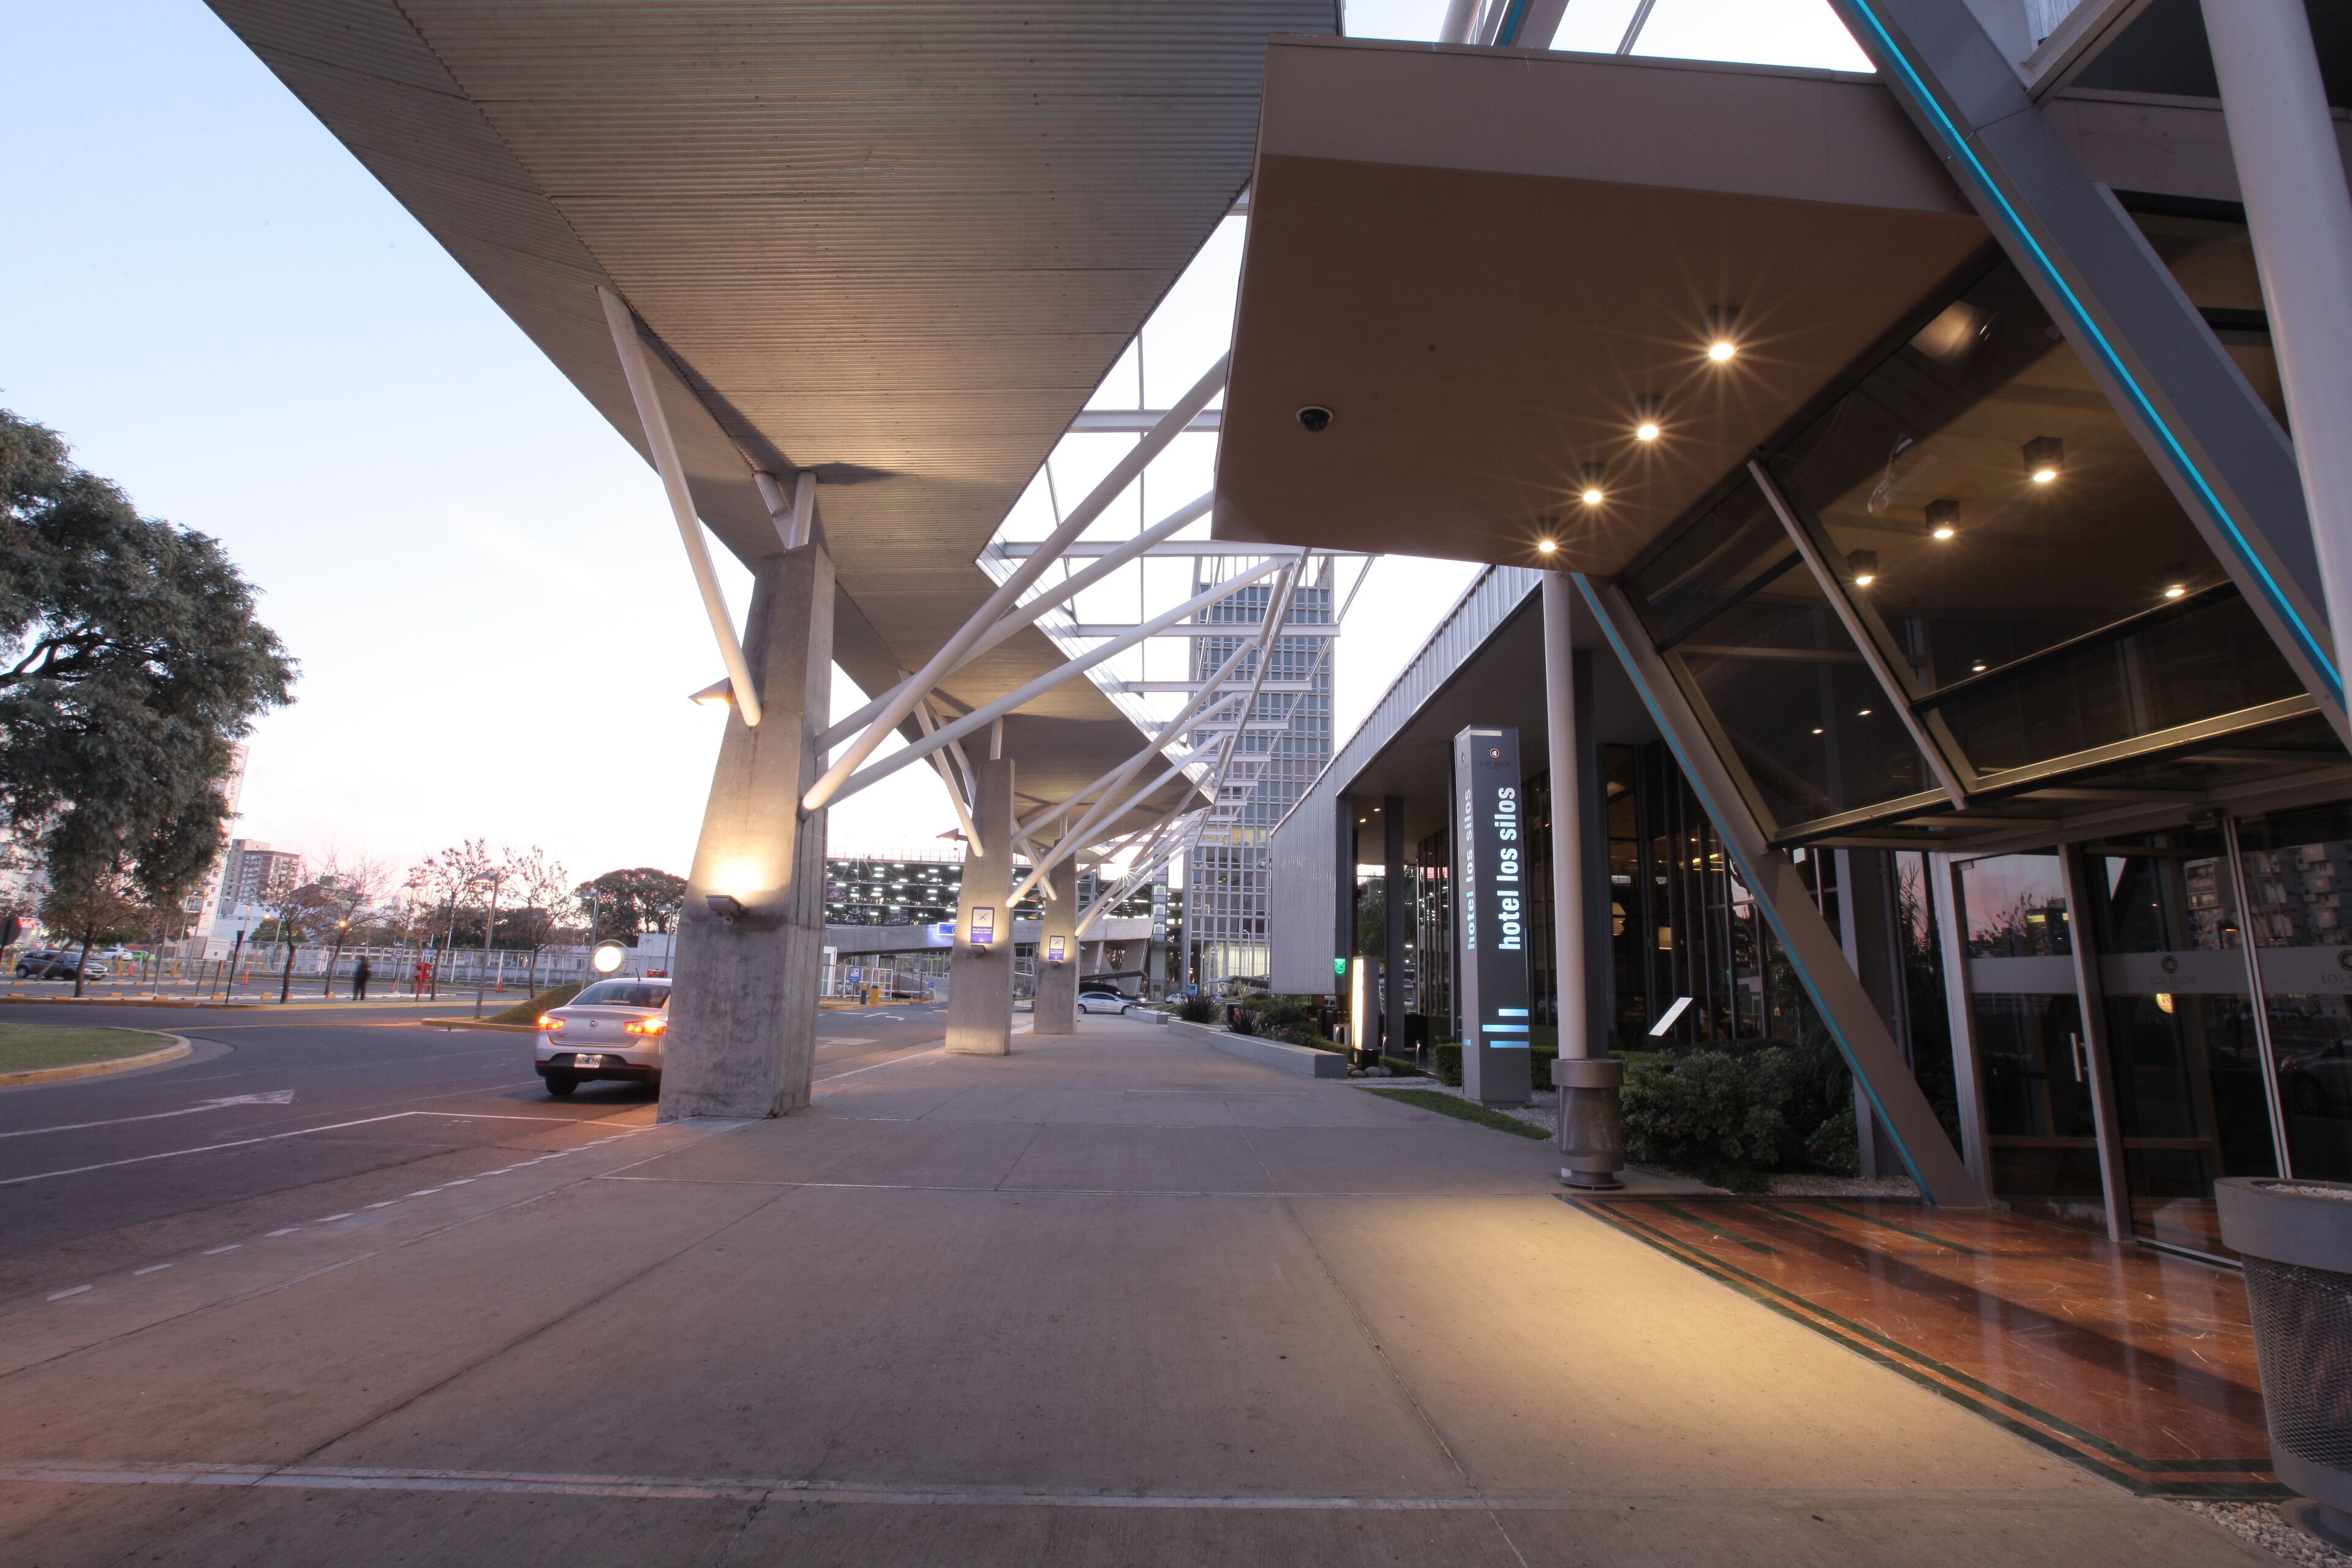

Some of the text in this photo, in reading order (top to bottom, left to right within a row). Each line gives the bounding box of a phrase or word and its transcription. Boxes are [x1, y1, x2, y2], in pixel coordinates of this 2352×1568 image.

[1494, 787, 1517, 840] silos
[1496, 848, 1518, 881] los
[1466, 891, 1475, 949] hotel
[1497, 891, 1520, 949] hotel
[2149, 974, 2196, 986] LOS SILOS
[2321, 973, 2345, 984] LOS
